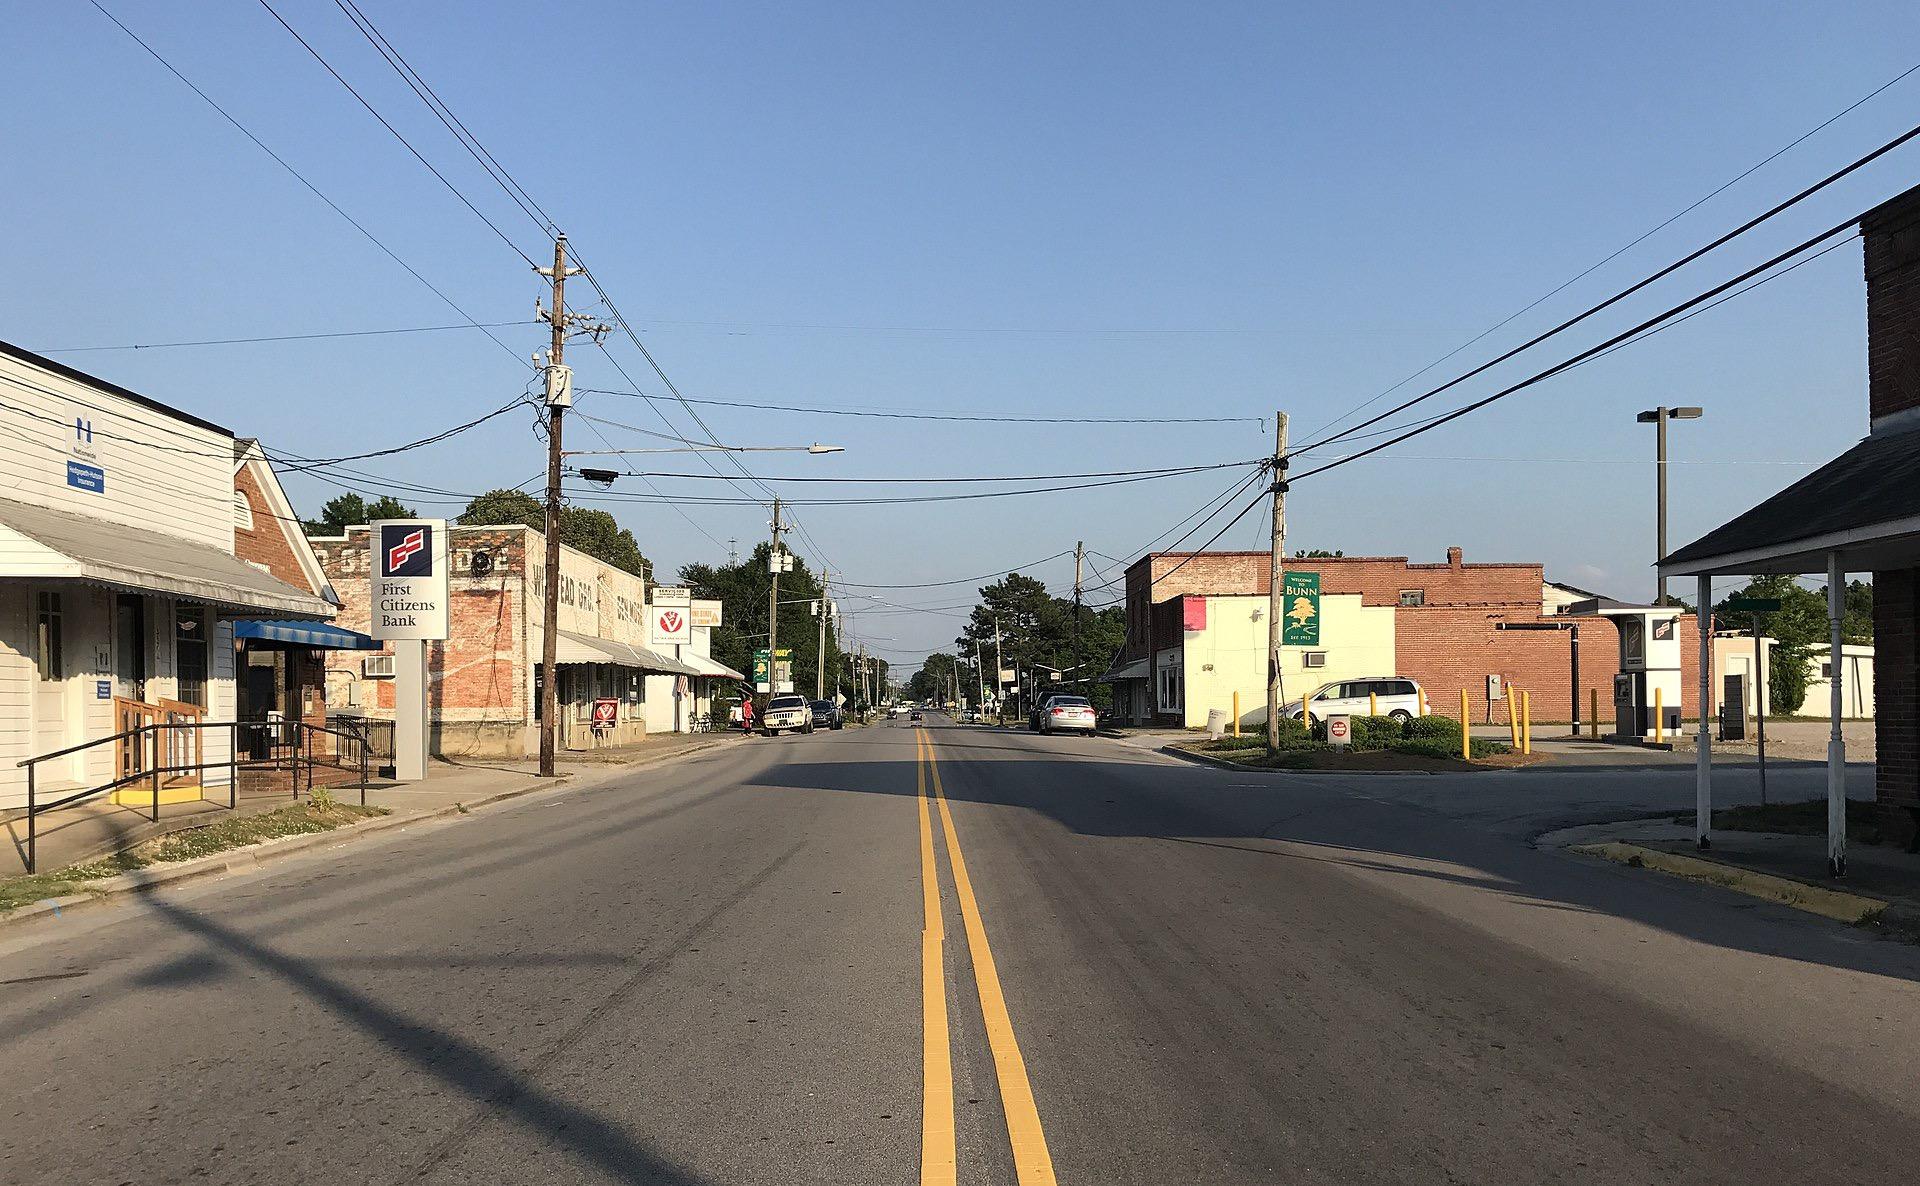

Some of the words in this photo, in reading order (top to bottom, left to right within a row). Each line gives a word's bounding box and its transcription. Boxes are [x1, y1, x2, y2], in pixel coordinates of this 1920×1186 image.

[381, 583, 412, 596] First
[1286, 585, 1317, 596] BUNN
[380, 599, 436, 612] Citizens
[381, 614, 417, 627] Bank
